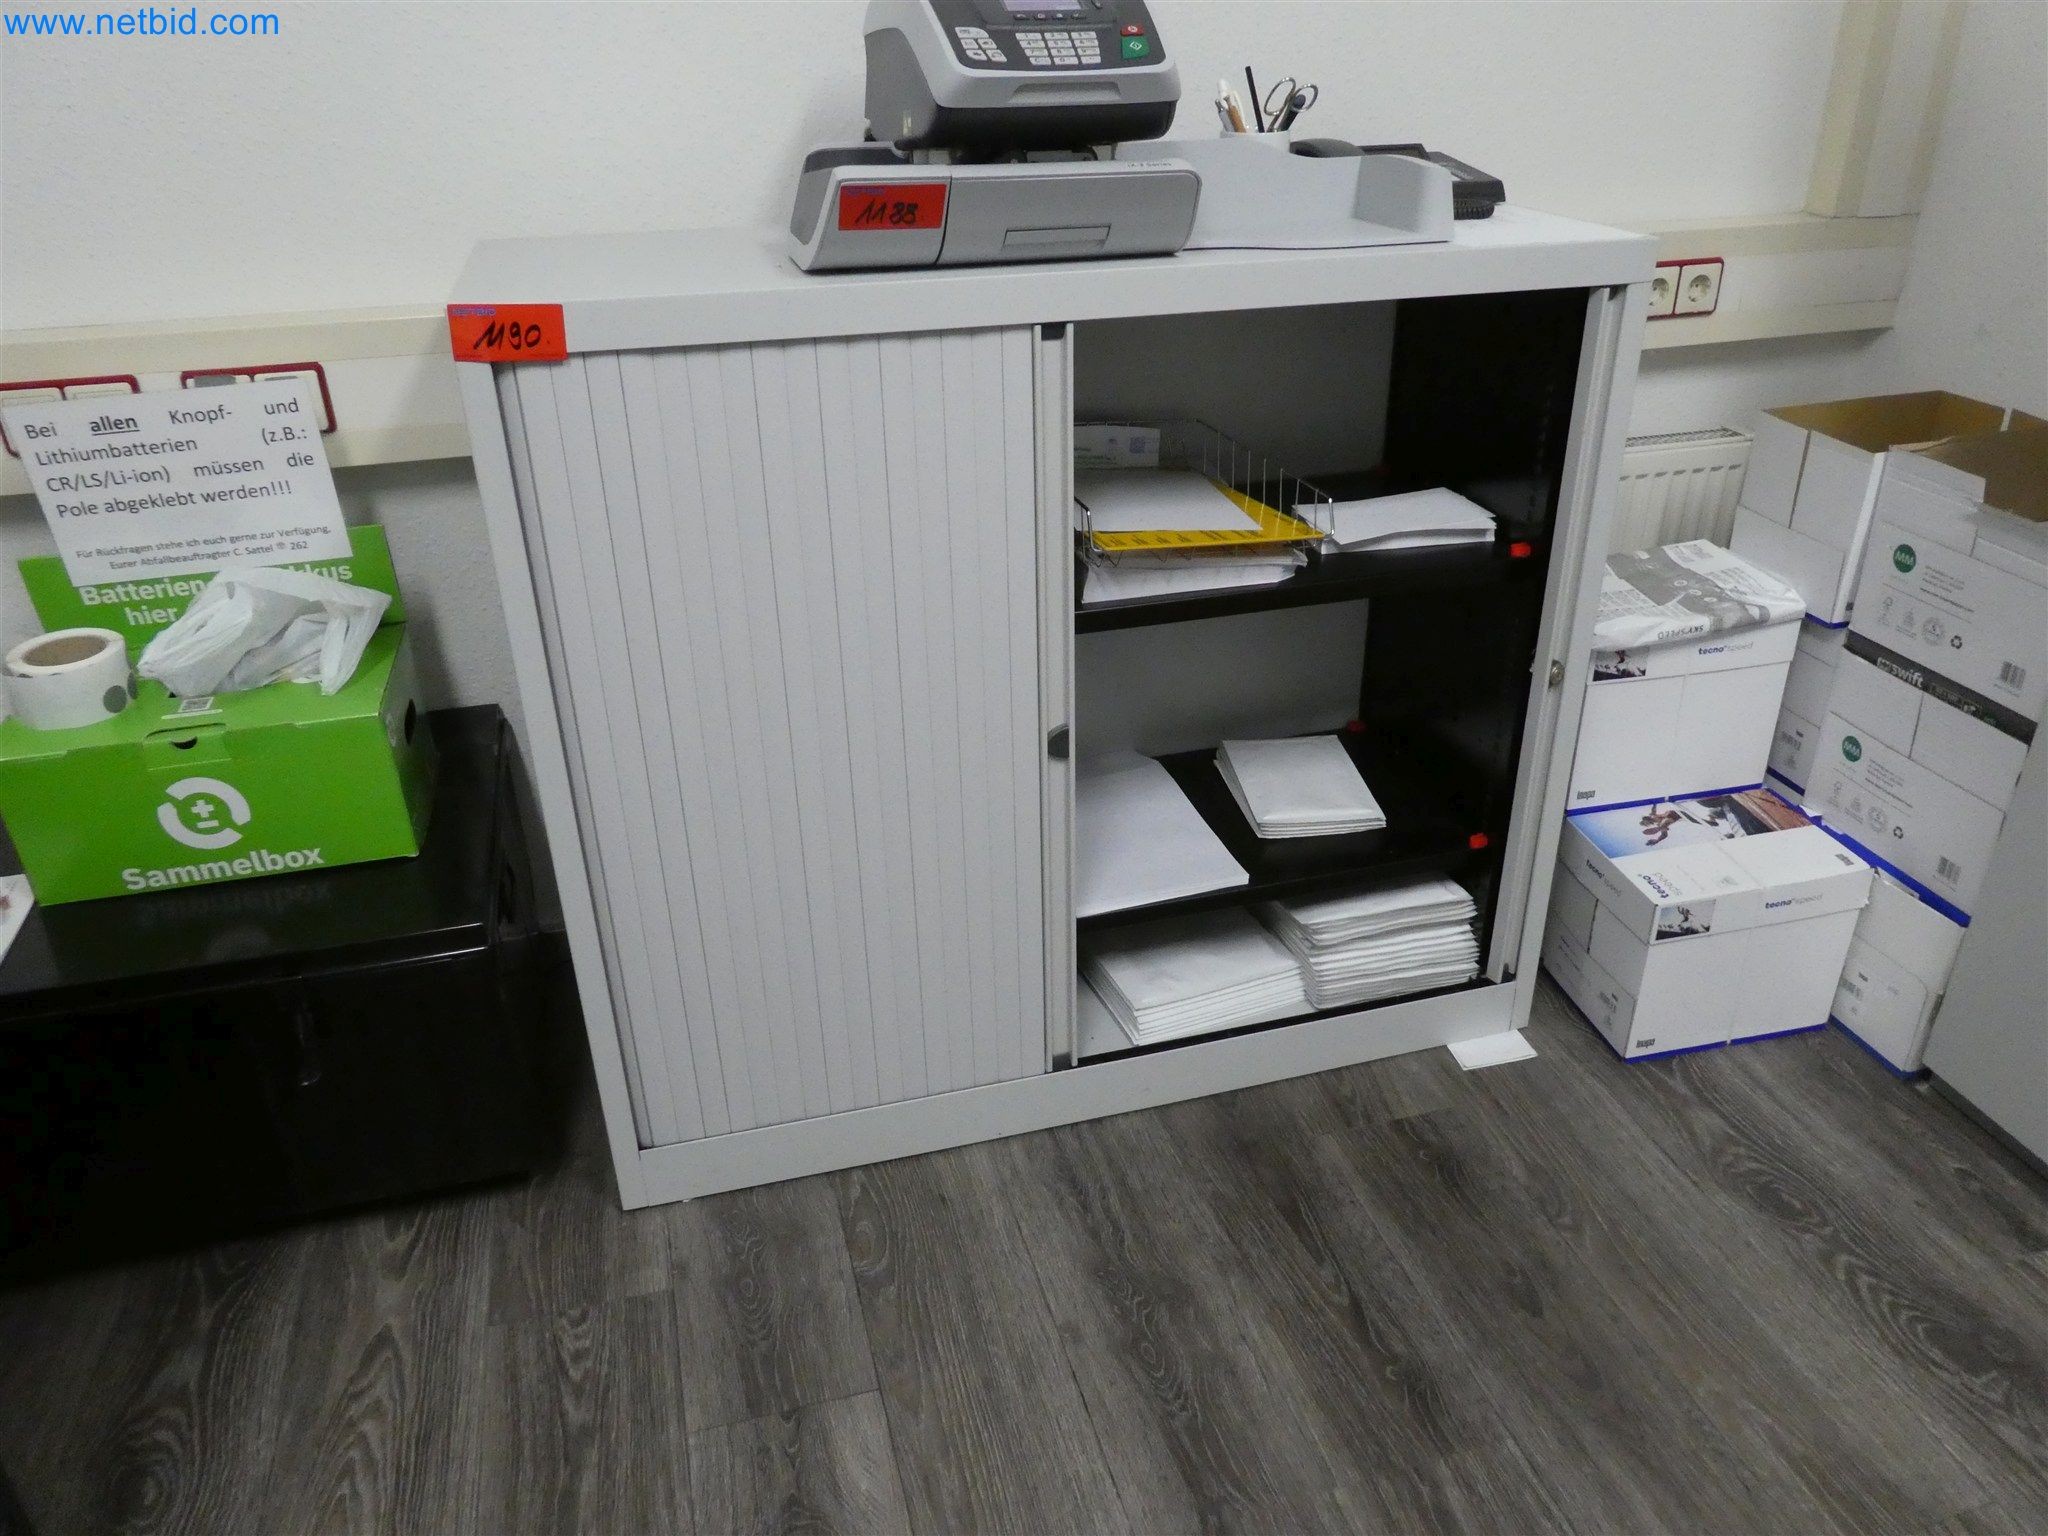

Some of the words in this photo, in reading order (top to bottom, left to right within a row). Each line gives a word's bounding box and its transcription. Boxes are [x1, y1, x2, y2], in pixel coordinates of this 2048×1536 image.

[472, 320, 541, 351] 1190
[24, 422, 58, 440] Bei
[89, 415, 140, 435] allen
[169, 404, 232, 425] Knopf-
[264, 397, 299, 416] und
[35, 438, 198, 467] Lithiumbatterien
[261, 426, 308, 446] (z.B.:
[46, 465, 171, 492] CR/LS/Li-ion)
[193, 459, 264, 478] müssen
[286, 452, 315, 468] die
[56, 501, 99, 518] Pole
[105, 491, 197, 514] abgeklebt
[201, 479, 292, 503] werden!!!
[75, 549, 93, 559] Für
[95, 543, 154, 557] Rückfragen
[155, 540, 184, 551] stehe
[186, 537, 201, 547] ich
[203, 535, 227, 546] euch
[229, 532, 257, 545] gerne
[260, 531, 276, 540] zur
[290, 541, 309, 551] 262
[79, 578, 206, 606] Batterien
[124, 605, 178, 626] hier
[121, 847, 325, 890] Sammelbox
[1642, 875, 1670, 899] tecno
